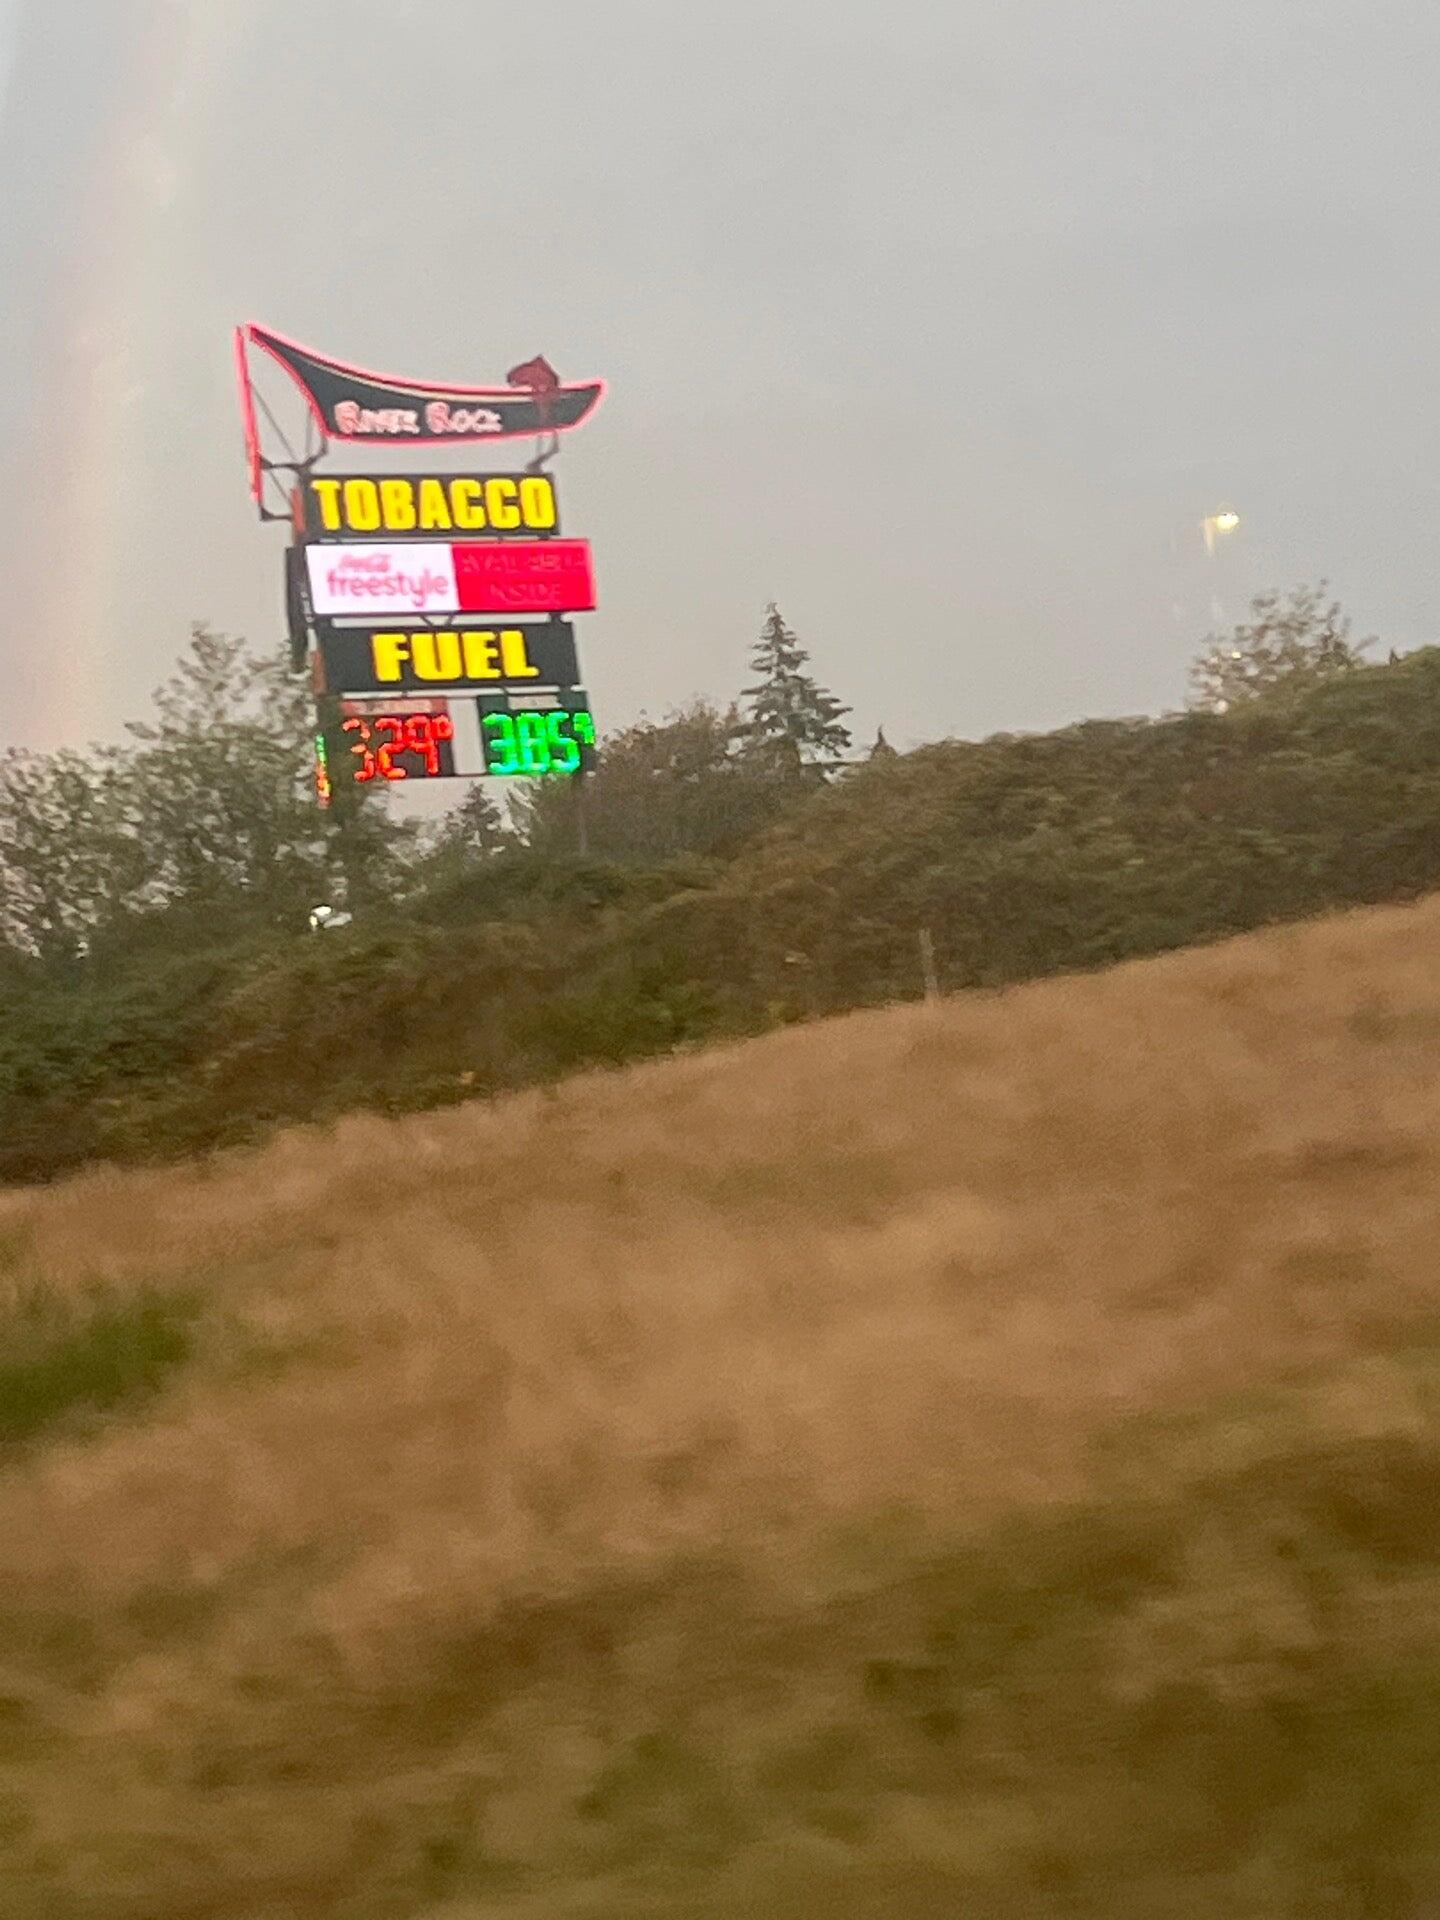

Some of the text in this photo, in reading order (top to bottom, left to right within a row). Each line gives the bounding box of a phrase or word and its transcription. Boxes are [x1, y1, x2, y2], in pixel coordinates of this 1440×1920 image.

[313, 477, 556, 531] TOBACCO
[327, 569, 449, 607] freestyle
[371, 630, 539, 682] FUEL
